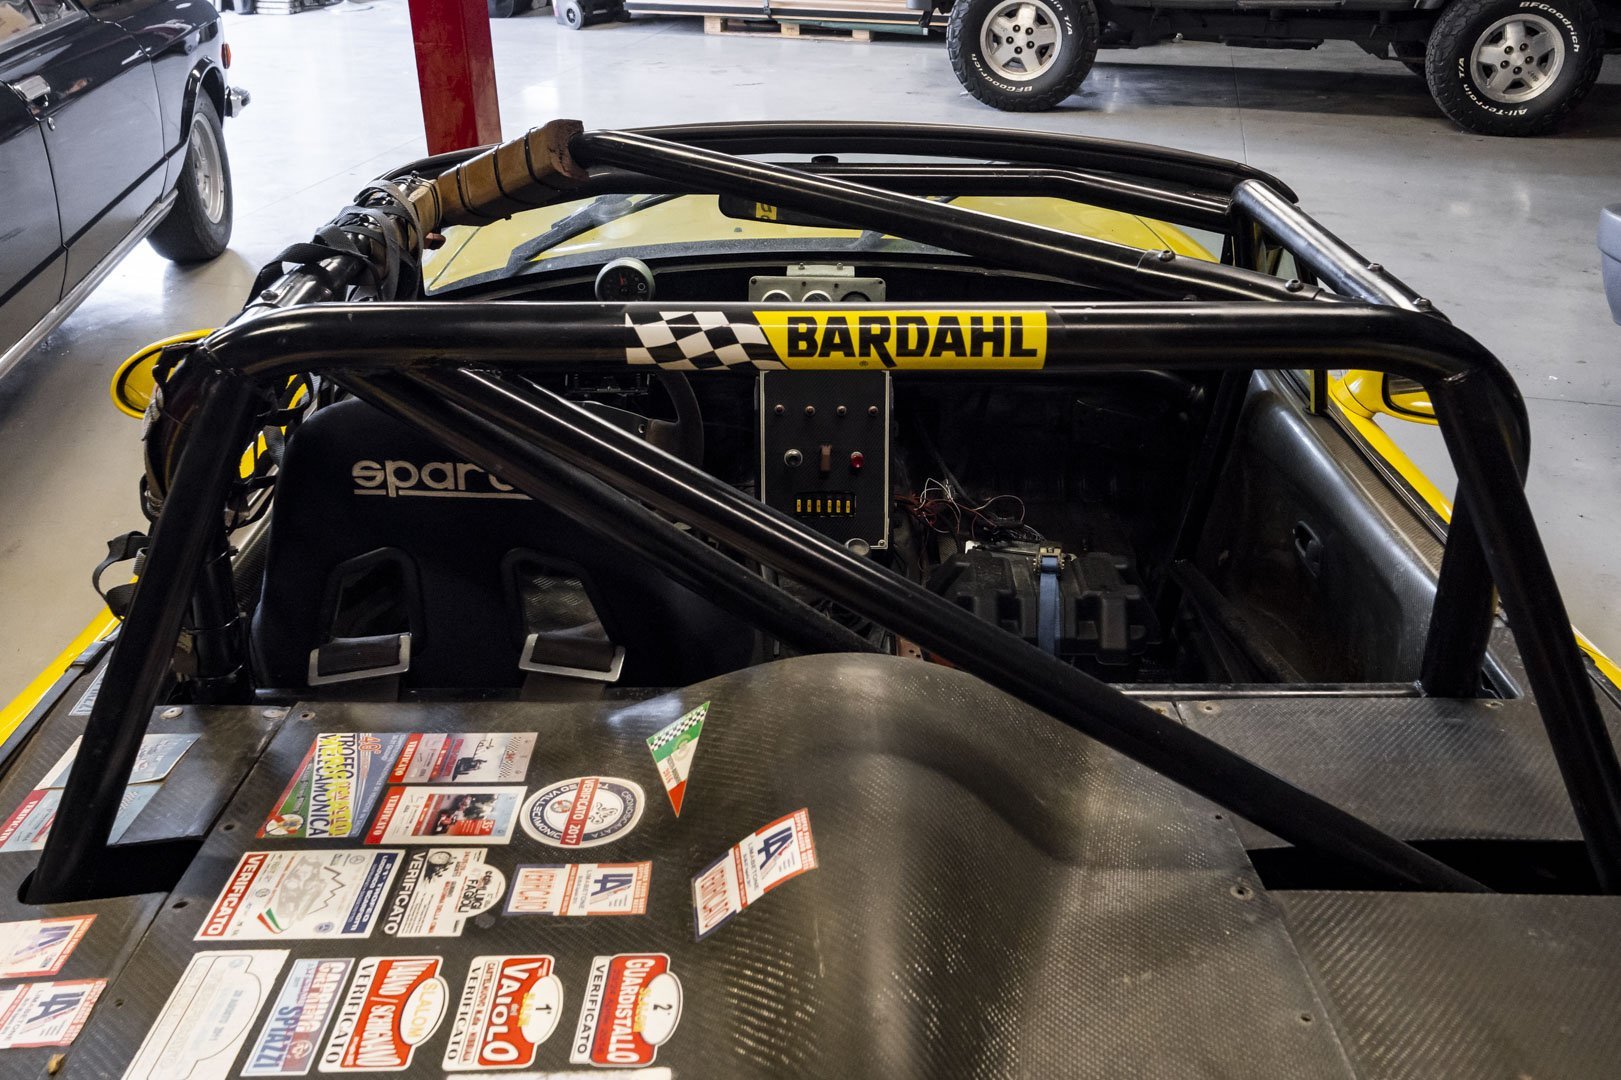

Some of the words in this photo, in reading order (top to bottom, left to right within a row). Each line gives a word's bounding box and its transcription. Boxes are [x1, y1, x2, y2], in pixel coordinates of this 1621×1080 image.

[1519, 1, 1581, 53] BFGoodrich
[971, 53, 1033, 93] BFGoodrich
[1463, 84, 1528, 116] All-Terrain
[787, 315, 1038, 368] BARDAHL
[352, 460, 514, 498] spar
[335, 734, 355, 778] TROFEO
[394, 740, 418, 776] VERIFICATO
[309, 733, 337, 837] VALLECAMONICA
[573, 780, 595, 820] VERIFICATO
[0, 800, 39, 842] VERIFICATO
[372, 795, 400, 835] VERIFICATO
[532, 790, 562, 841] VALLECAMONIC
[565, 825, 580, 843] 2017
[592, 791, 632, 837] CRONOSCALATA
[206, 854, 264, 934] VERIFICATO
[369, 855, 388, 887] LODOVICO
[384, 852, 428, 935] VERIFICATO
[361, 882, 383, 922] TROFEO
[458, 879, 479, 913] FAGIOLI
[325, 964, 376, 1064] VERIFICATO
[408, 983, 437, 1038] SLALOM
[447, 967, 482, 1060] VERIFICATO
[482, 962, 544, 1061] VAIOLO
[577, 965, 607, 1054] VERIFICATO
[606, 958, 656, 1062] GUARDISTALLO
[633, 987, 652, 1031] SLALOM
[253, 1006, 305, 1069] SPIAZZI
[355, 1005, 402, 1066] SCHIGNANO
